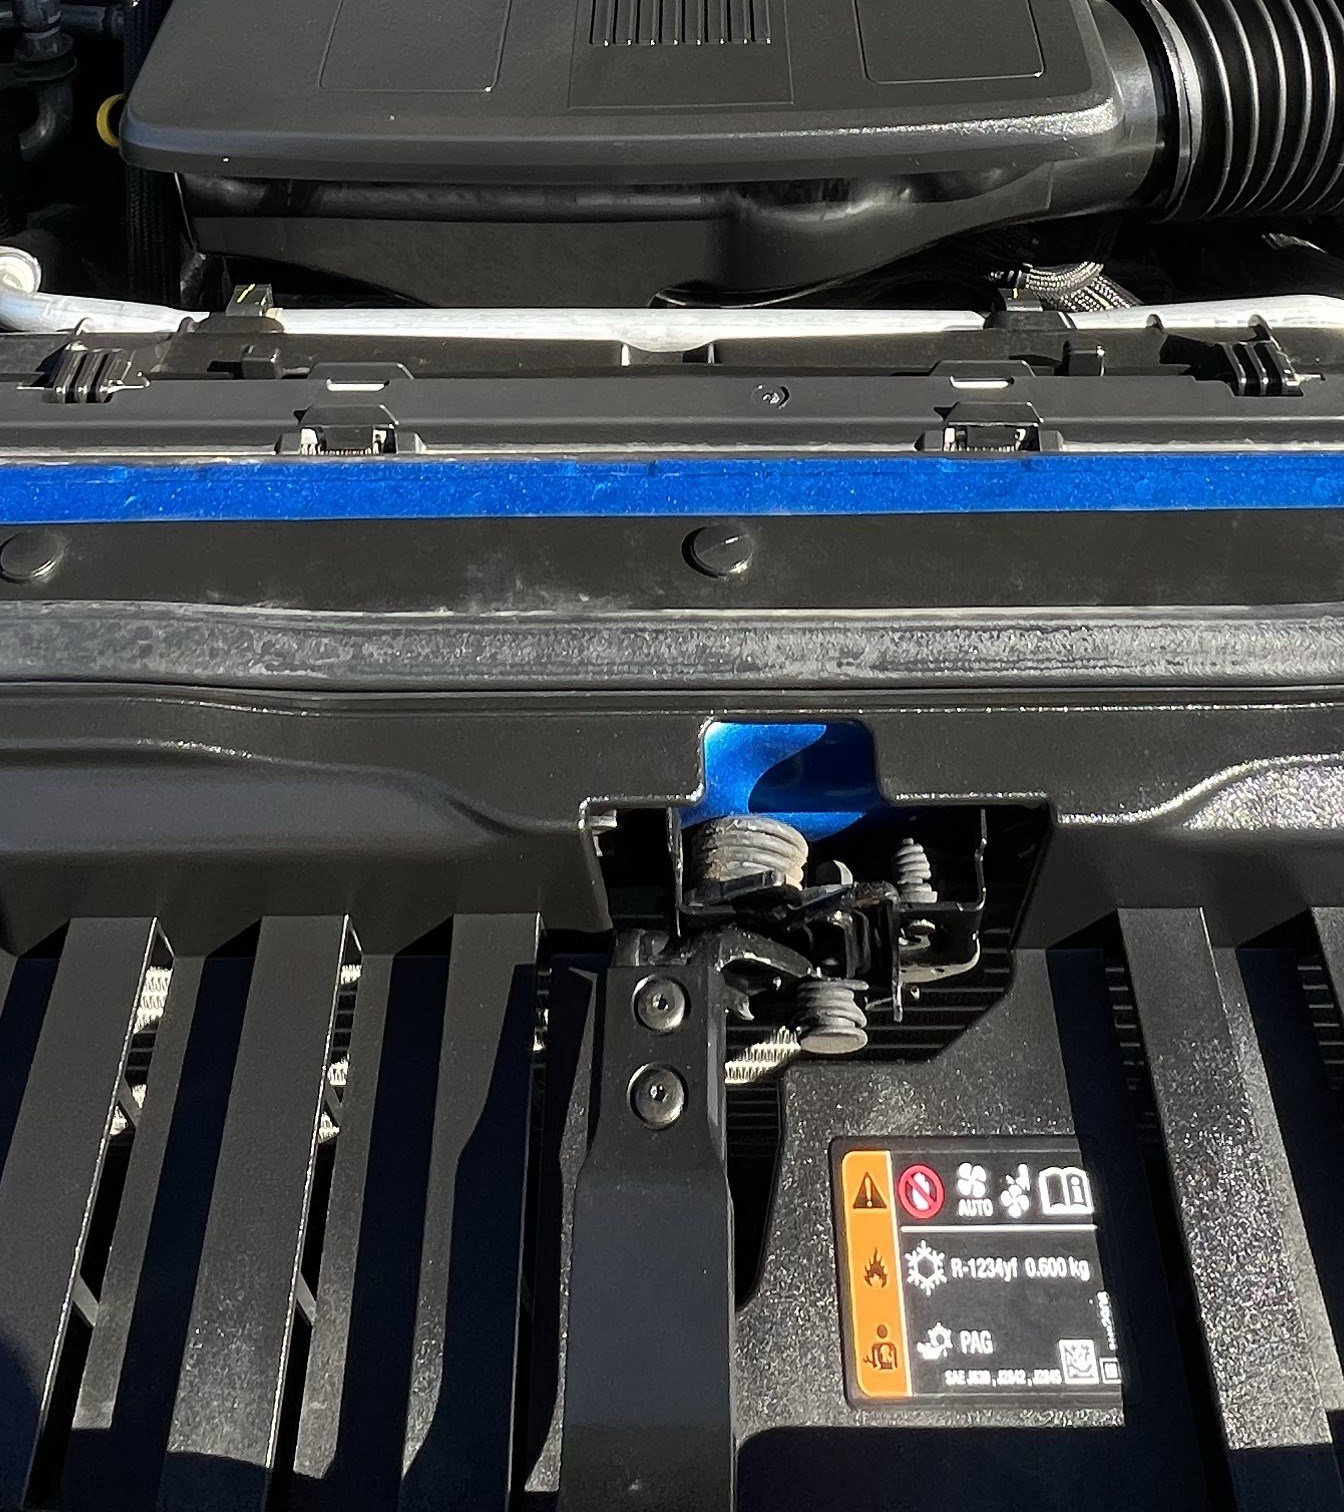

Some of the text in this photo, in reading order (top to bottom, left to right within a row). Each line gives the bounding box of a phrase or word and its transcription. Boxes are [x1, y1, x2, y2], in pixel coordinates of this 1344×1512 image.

[958, 1198, 994, 1217] AUTO
[950, 1255, 1090, 1282] R-1234yf 0.600 kg
[960, 1330, 994, 1355] PAG
